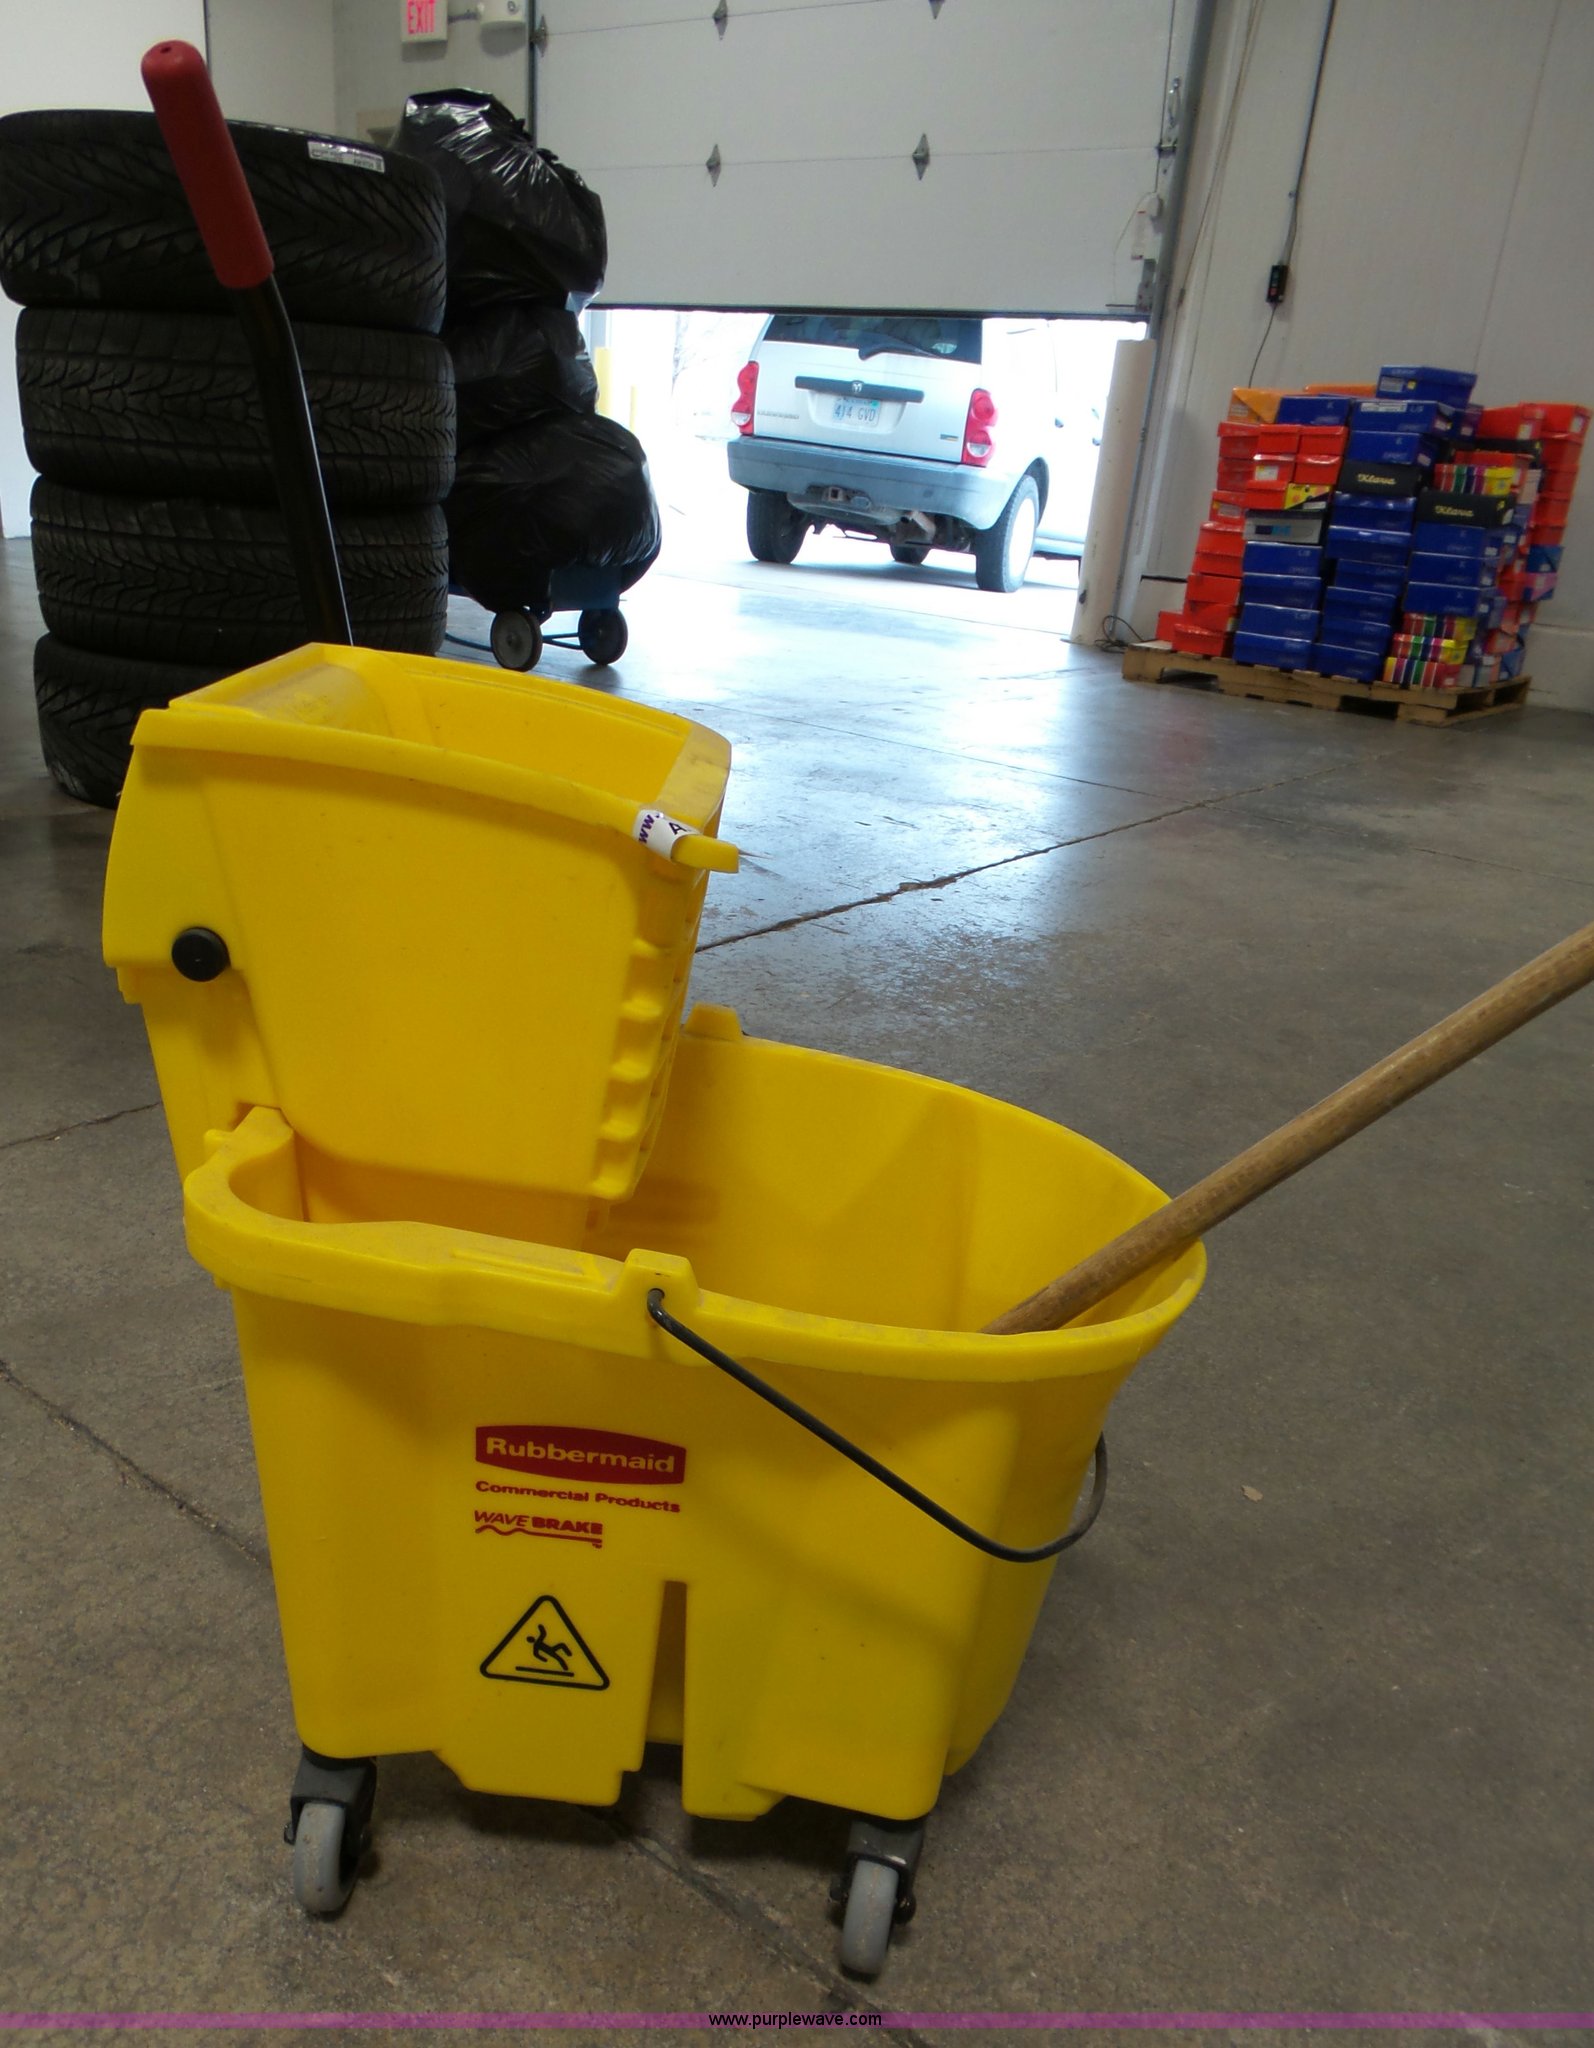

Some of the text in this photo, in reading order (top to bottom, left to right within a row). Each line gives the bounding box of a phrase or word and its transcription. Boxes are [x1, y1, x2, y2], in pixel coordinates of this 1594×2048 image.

[407, 0, 435, 34] EXIT
[485, 1436, 676, 1474] Rubbermaid
[475, 1480, 681, 1514] Commercial Products
